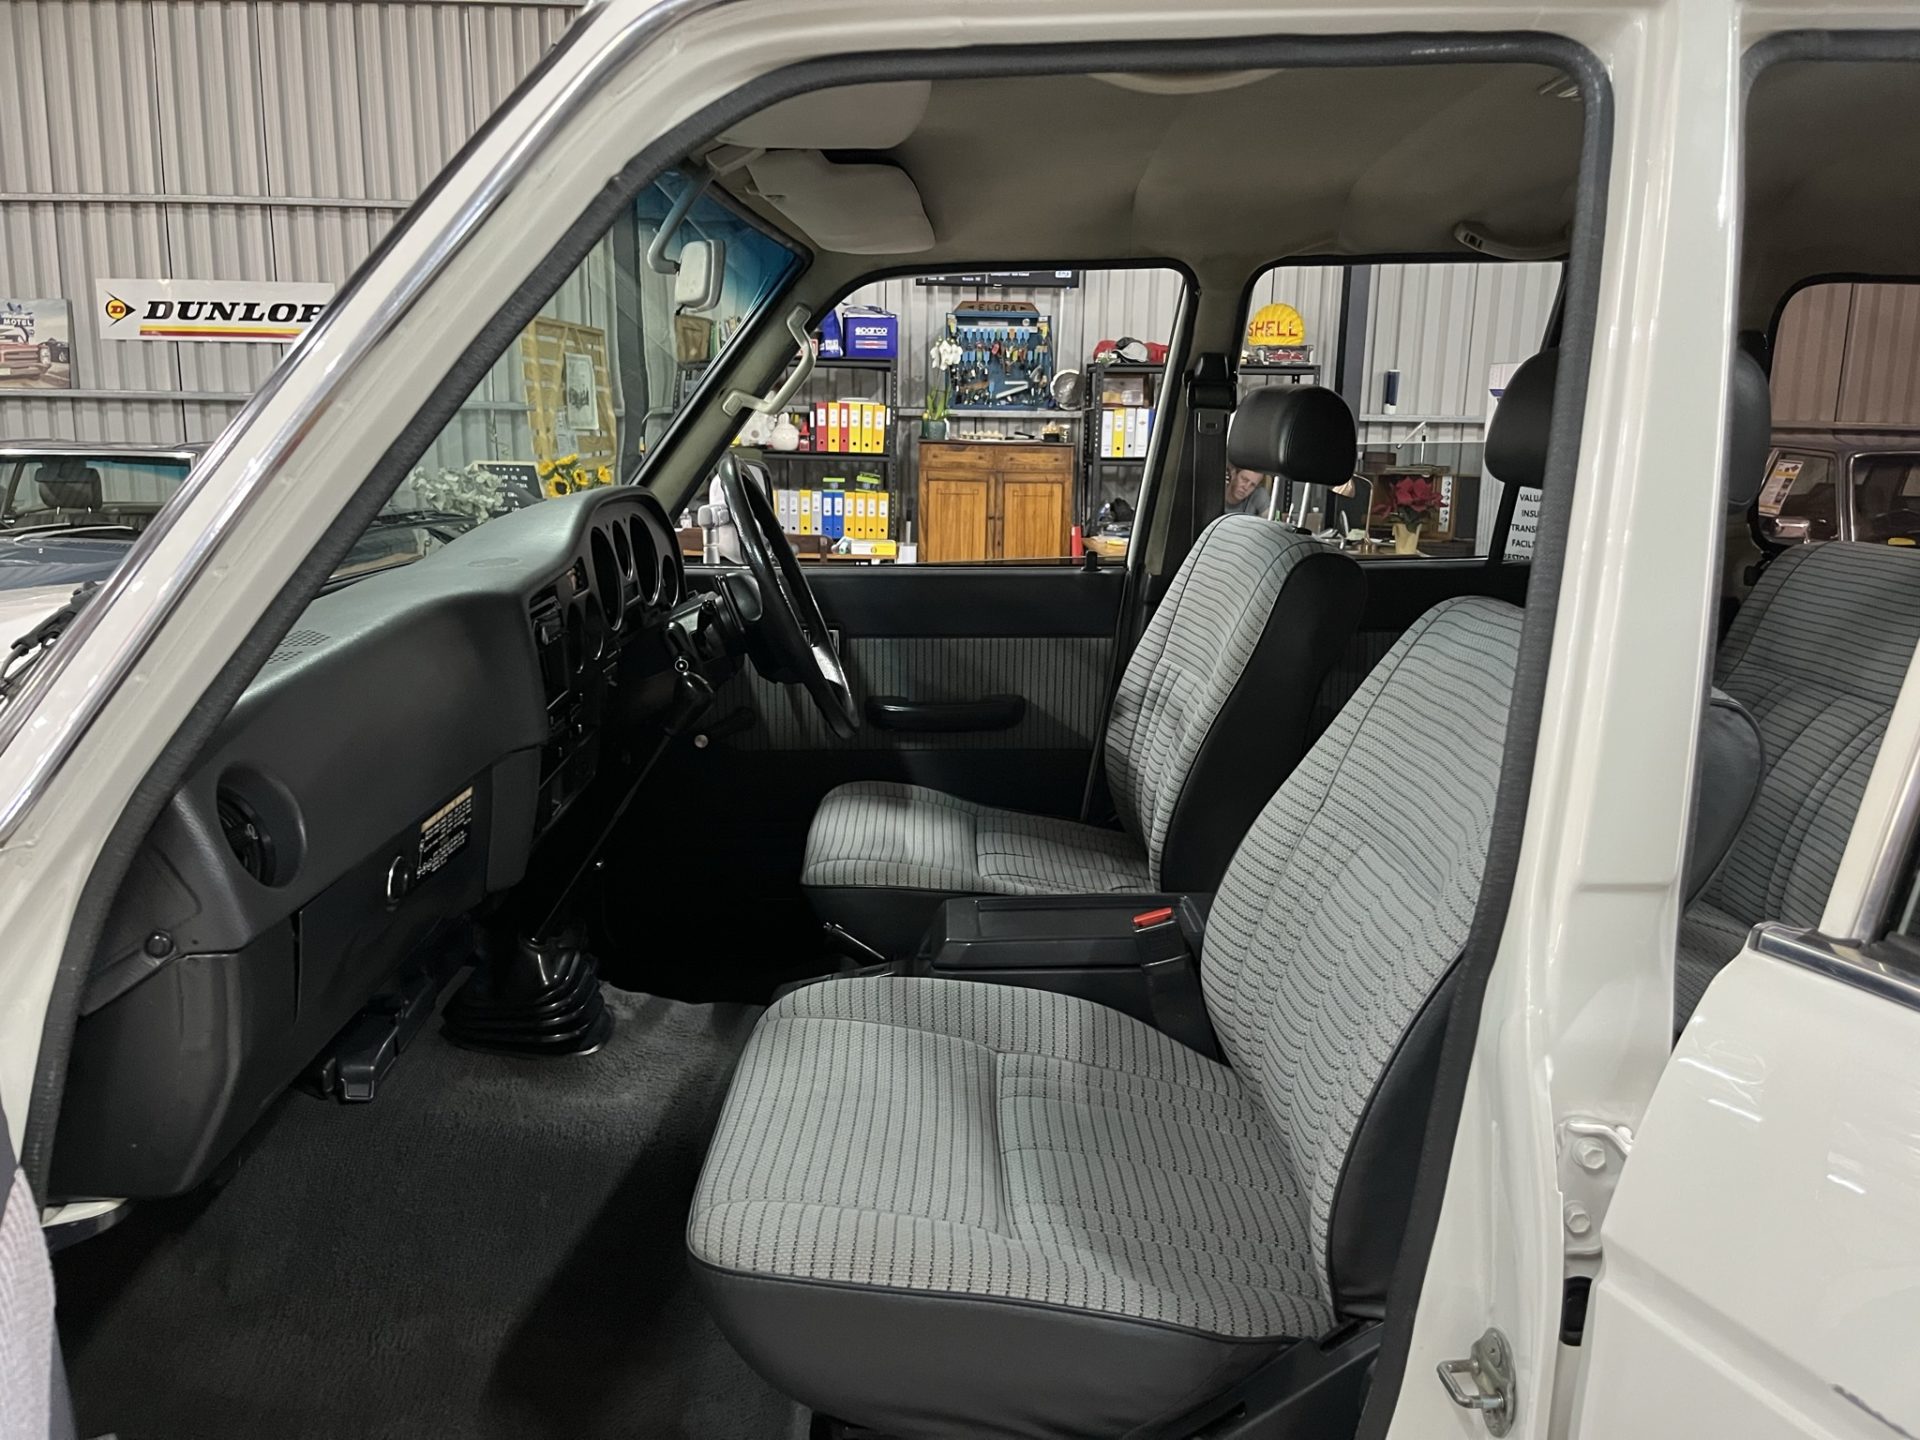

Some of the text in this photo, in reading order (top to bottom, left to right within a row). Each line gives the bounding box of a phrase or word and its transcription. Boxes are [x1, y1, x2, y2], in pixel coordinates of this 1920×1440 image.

[143, 301, 326, 323] DUNLOP
[978, 304, 1017, 312] ELORA
[3, 318, 33, 326] MOTEL
[1248, 320, 1298, 337] SHELL
